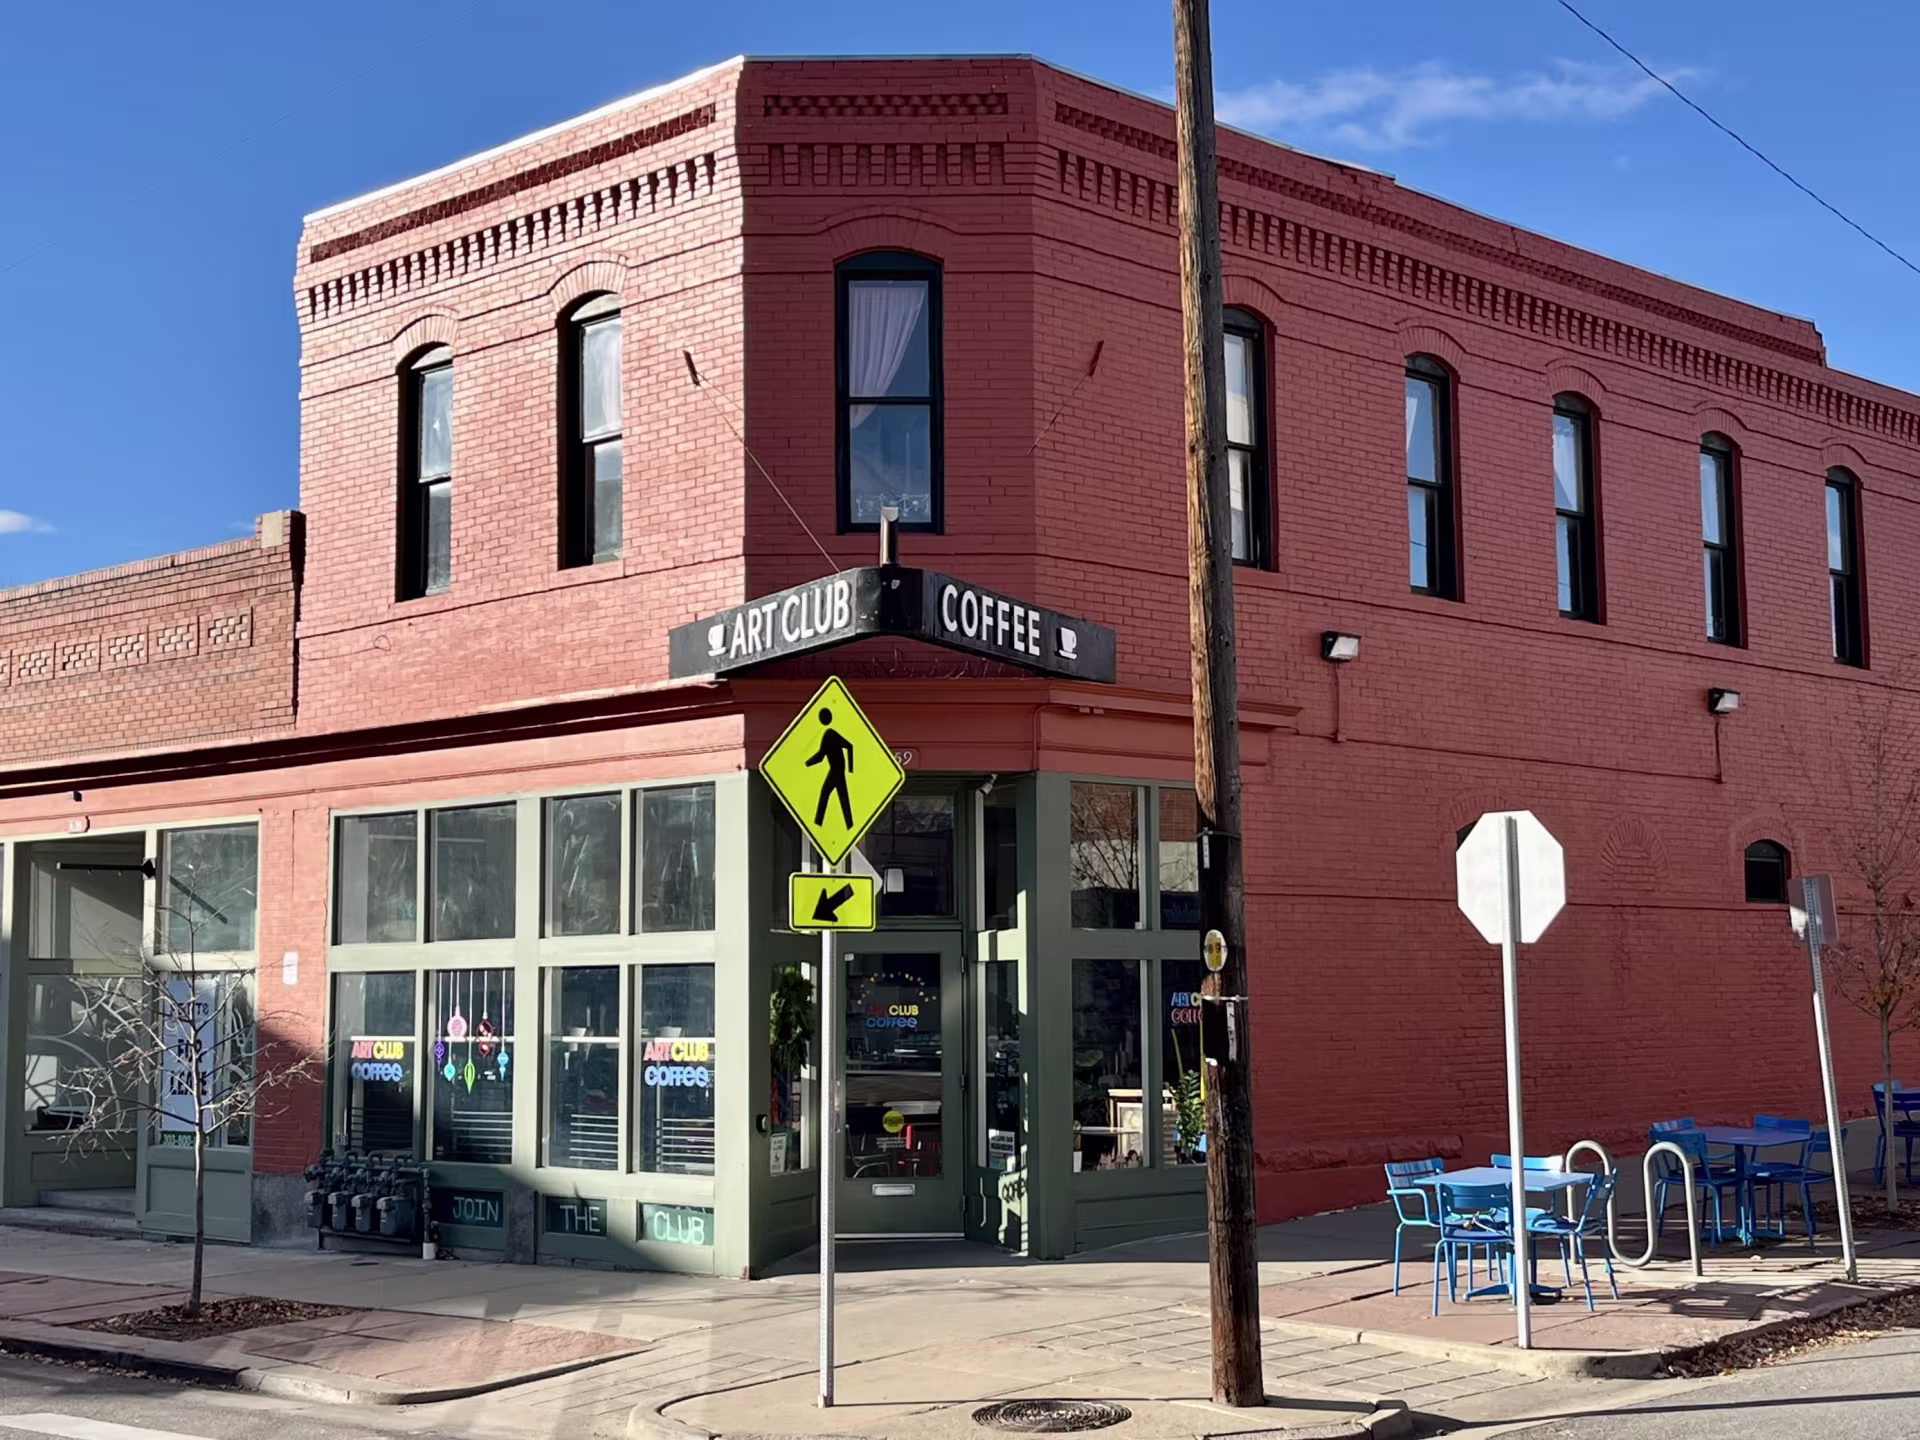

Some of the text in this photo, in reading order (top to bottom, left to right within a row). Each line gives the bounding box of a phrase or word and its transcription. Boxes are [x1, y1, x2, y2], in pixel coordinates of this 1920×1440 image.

[730, 579, 850, 659] ART CLUB
[942, 584, 1041, 656] COFFEE
[888, 1004, 919, 1016] CLUB
[351, 1040, 404, 1060] ART CLUB
[643, 1040, 709, 1062] ART CLUB
[169, 1070, 207, 1096] LEAE
[453, 1196, 706, 1246] JOIN THE CLUB
